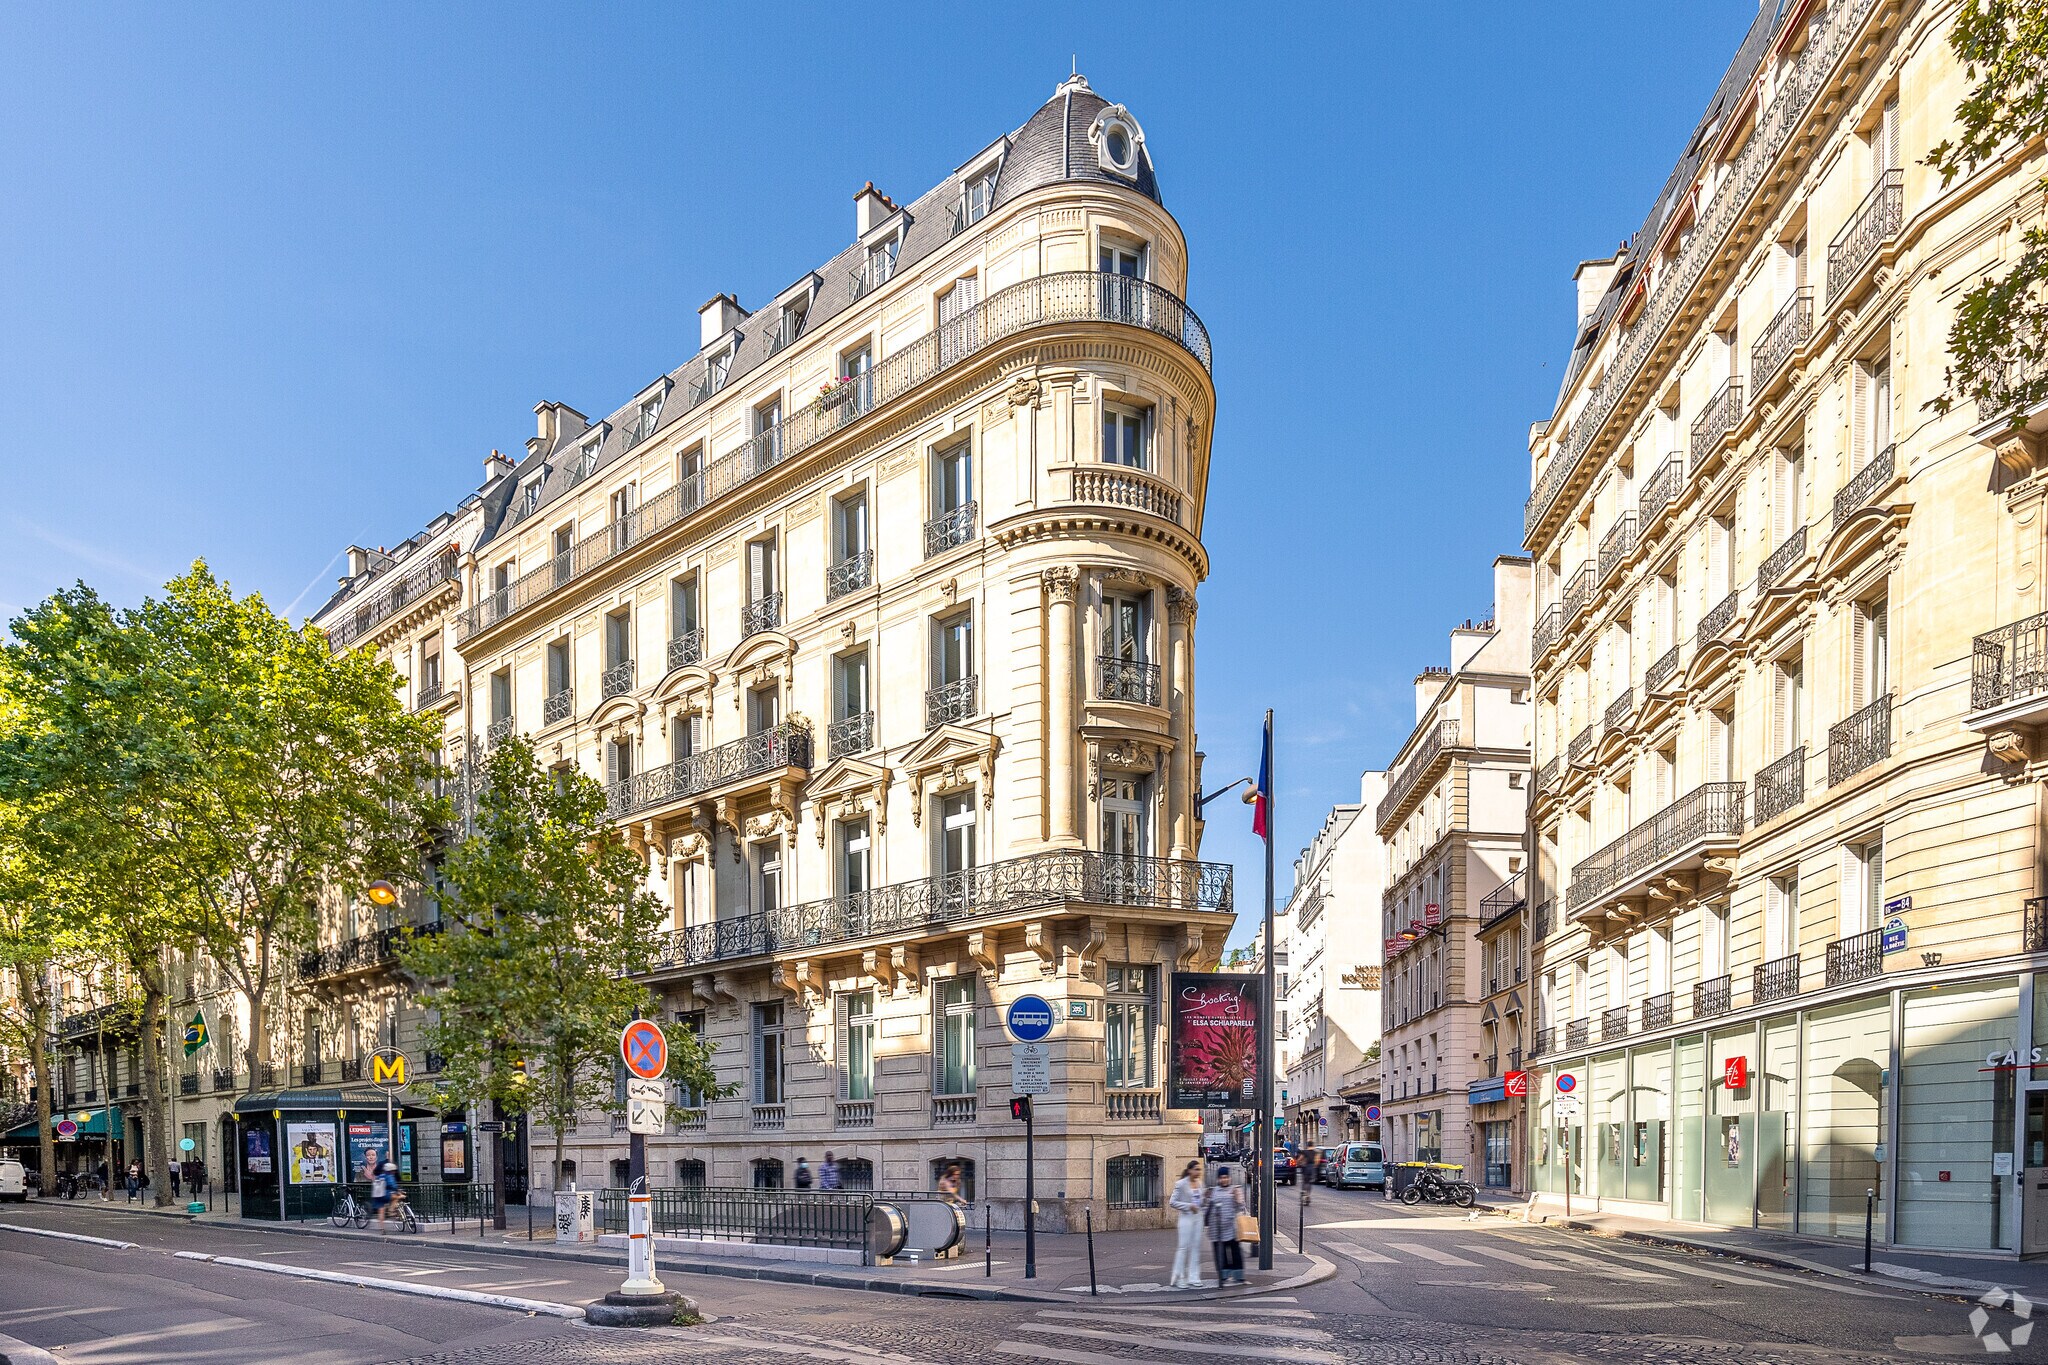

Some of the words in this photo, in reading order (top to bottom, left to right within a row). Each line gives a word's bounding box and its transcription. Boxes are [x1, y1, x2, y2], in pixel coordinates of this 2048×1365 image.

[1901, 897, 1910, 909] 84
[1180, 983, 1246, 1013] Shocking!
[1986, 1047, 2048, 1067] CAIS
[373, 1055, 405, 1084] M
